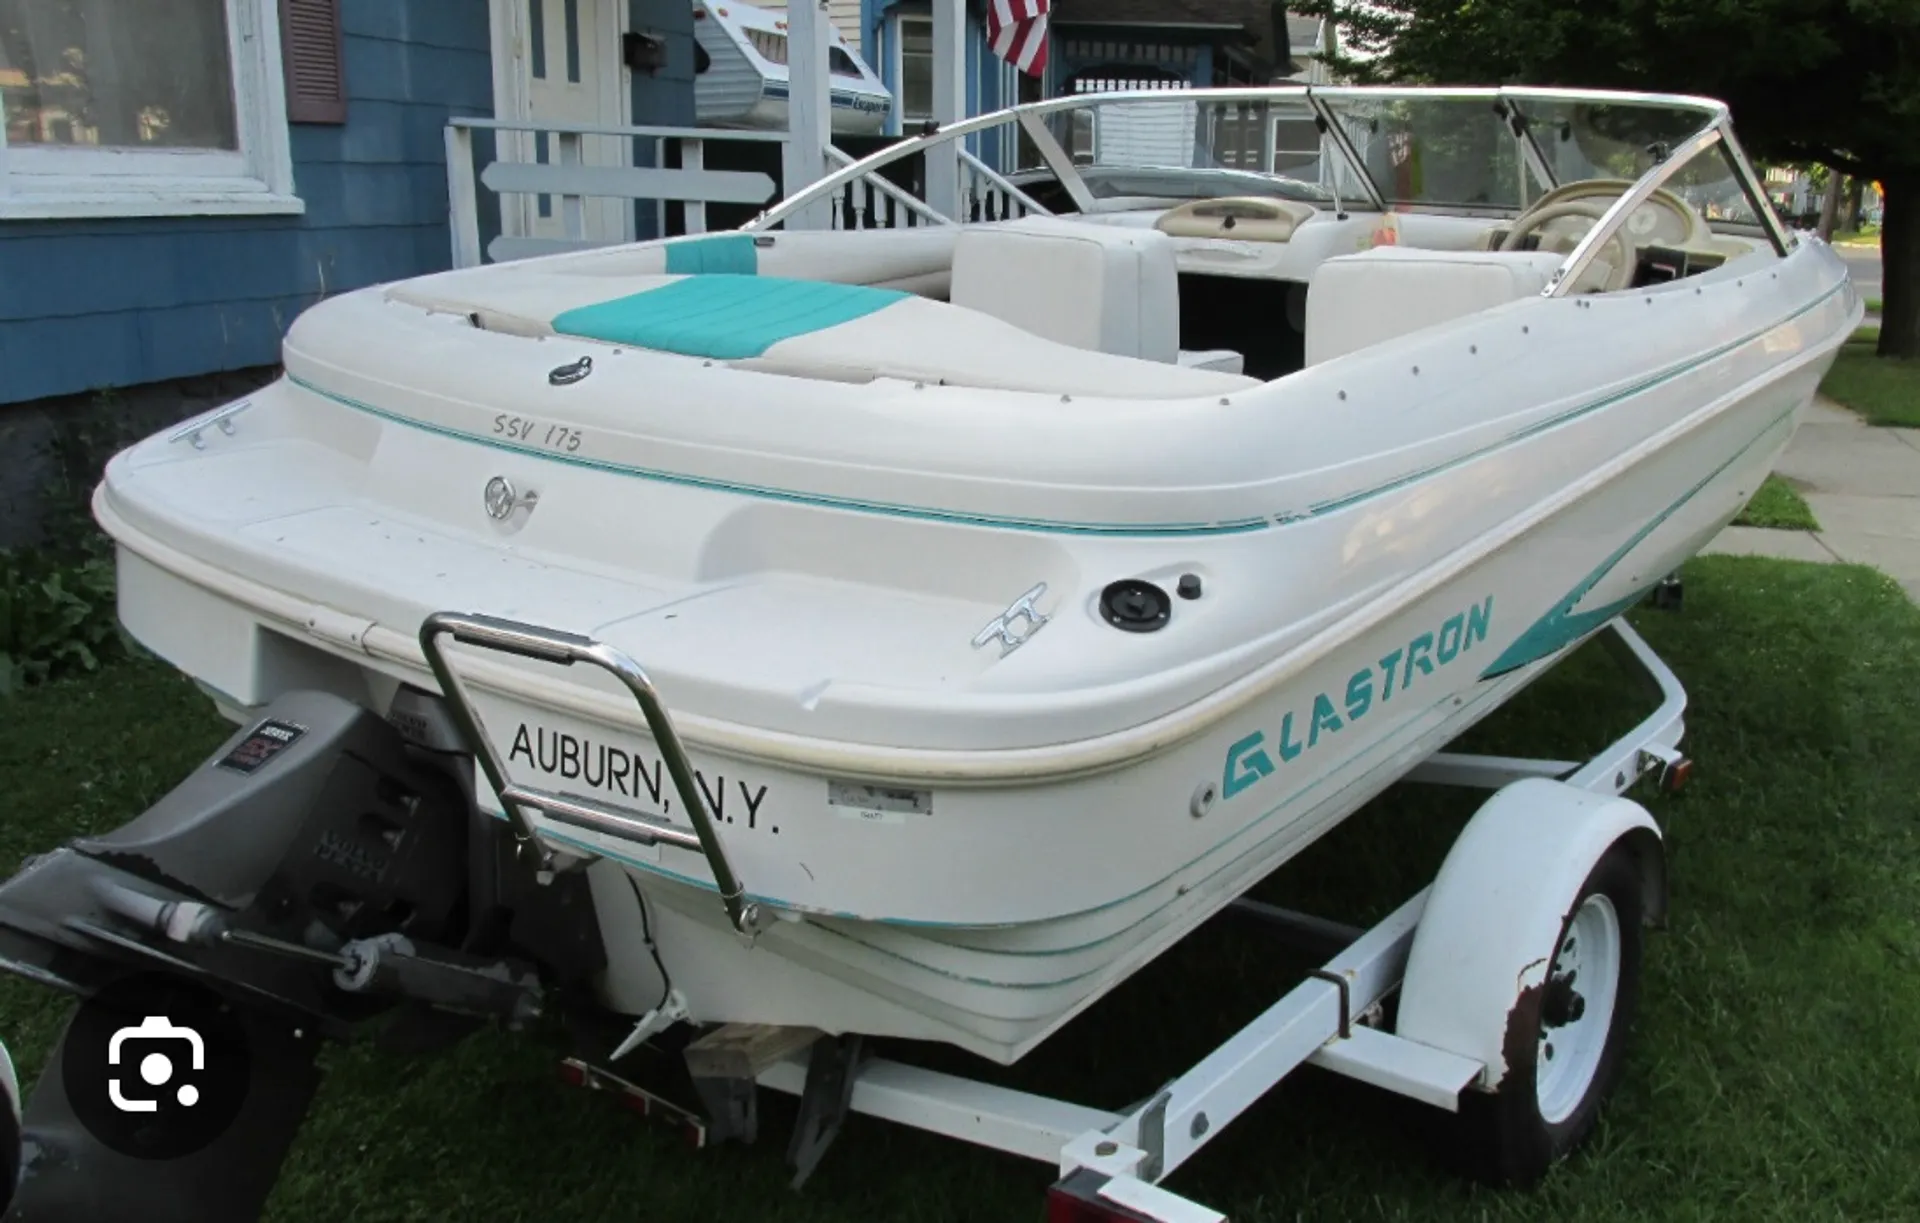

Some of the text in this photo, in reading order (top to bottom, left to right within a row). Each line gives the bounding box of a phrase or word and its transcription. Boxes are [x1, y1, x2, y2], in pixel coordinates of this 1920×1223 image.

[493, 414, 582, 452] SSV 175
[1222, 594, 1493, 800] GLASTRON
[509, 723, 670, 814] AUBURN,
[694, 769, 780, 834] N.Y.
